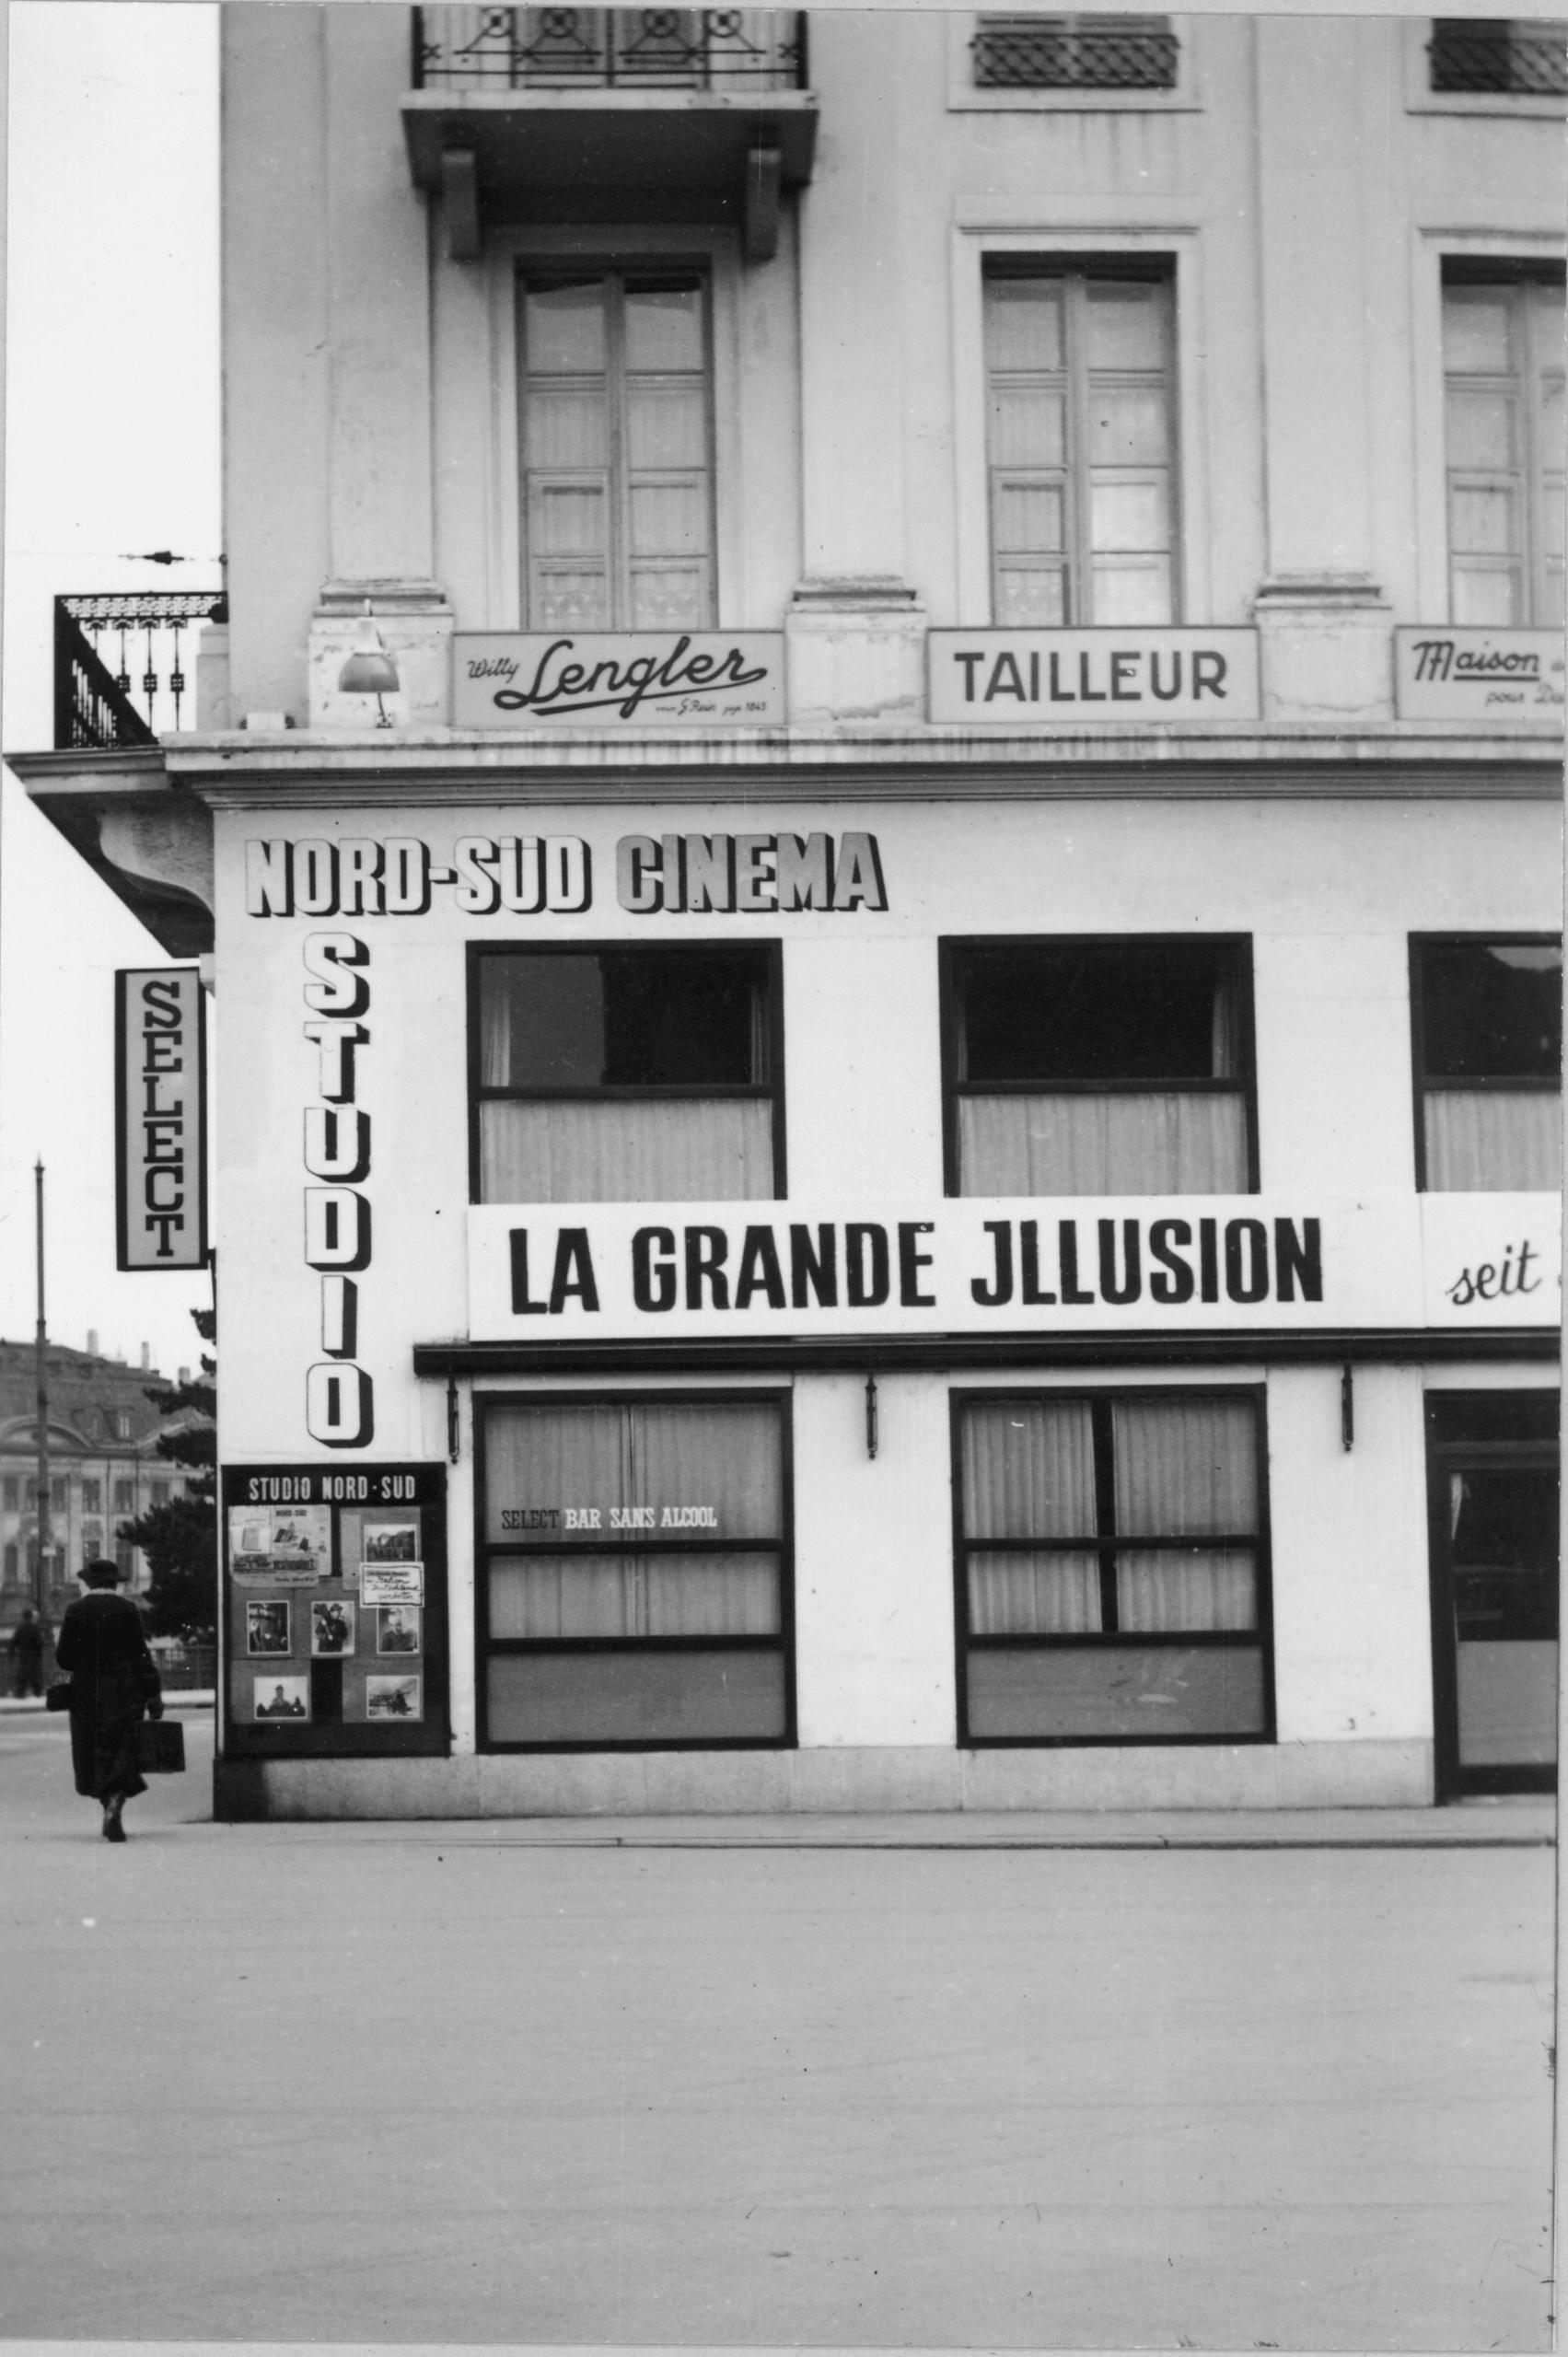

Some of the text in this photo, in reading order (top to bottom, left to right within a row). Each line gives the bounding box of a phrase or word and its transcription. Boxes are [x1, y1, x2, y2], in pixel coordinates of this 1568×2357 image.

[467, 635, 768, 719] Willy Lengler
[954, 651, 1227, 702] TAILLEUR
[1411, 641, 1540, 681] Maison
[245, 831, 889, 919] NORD-SUD CINEMA
[142, 981, 185, 1258] SELECT
[303, 932, 374, 1449] STUDIO
[508, 1226, 600, 1315] LA
[631, 1222, 937, 1313] GRANDE
[1445, 1239, 1542, 1306] seit
[250, 1476, 311, 1501] STUDIO
[502, 1506, 718, 1530] SELECT BAR SANS ALCOOL
